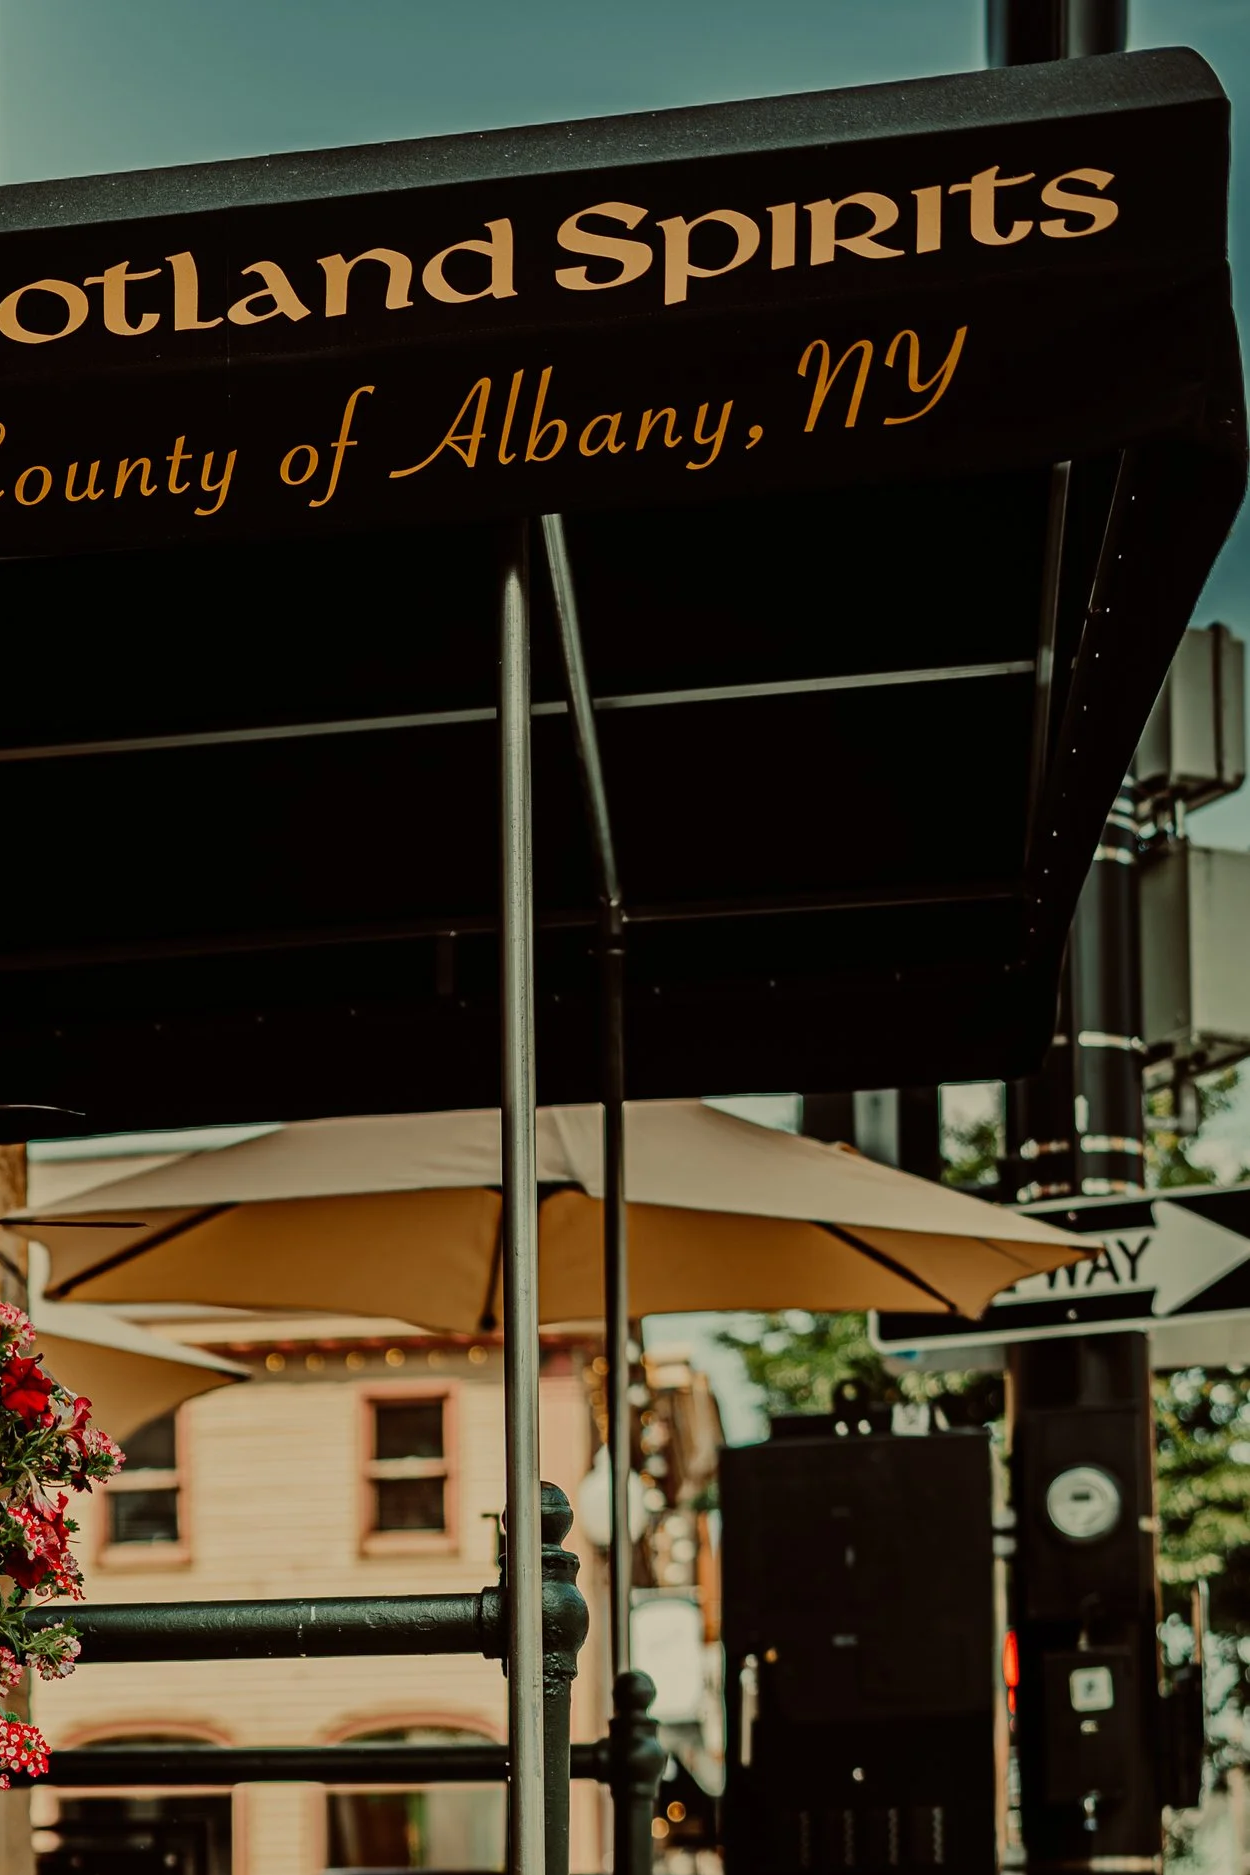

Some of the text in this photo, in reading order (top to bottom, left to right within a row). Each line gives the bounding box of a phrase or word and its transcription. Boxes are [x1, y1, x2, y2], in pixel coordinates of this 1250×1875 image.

[554, 165, 1119, 306] Spirits
[279, 385, 376, 508] of
[388, 365, 764, 479] Albany,
[797, 325, 968, 433] NY
